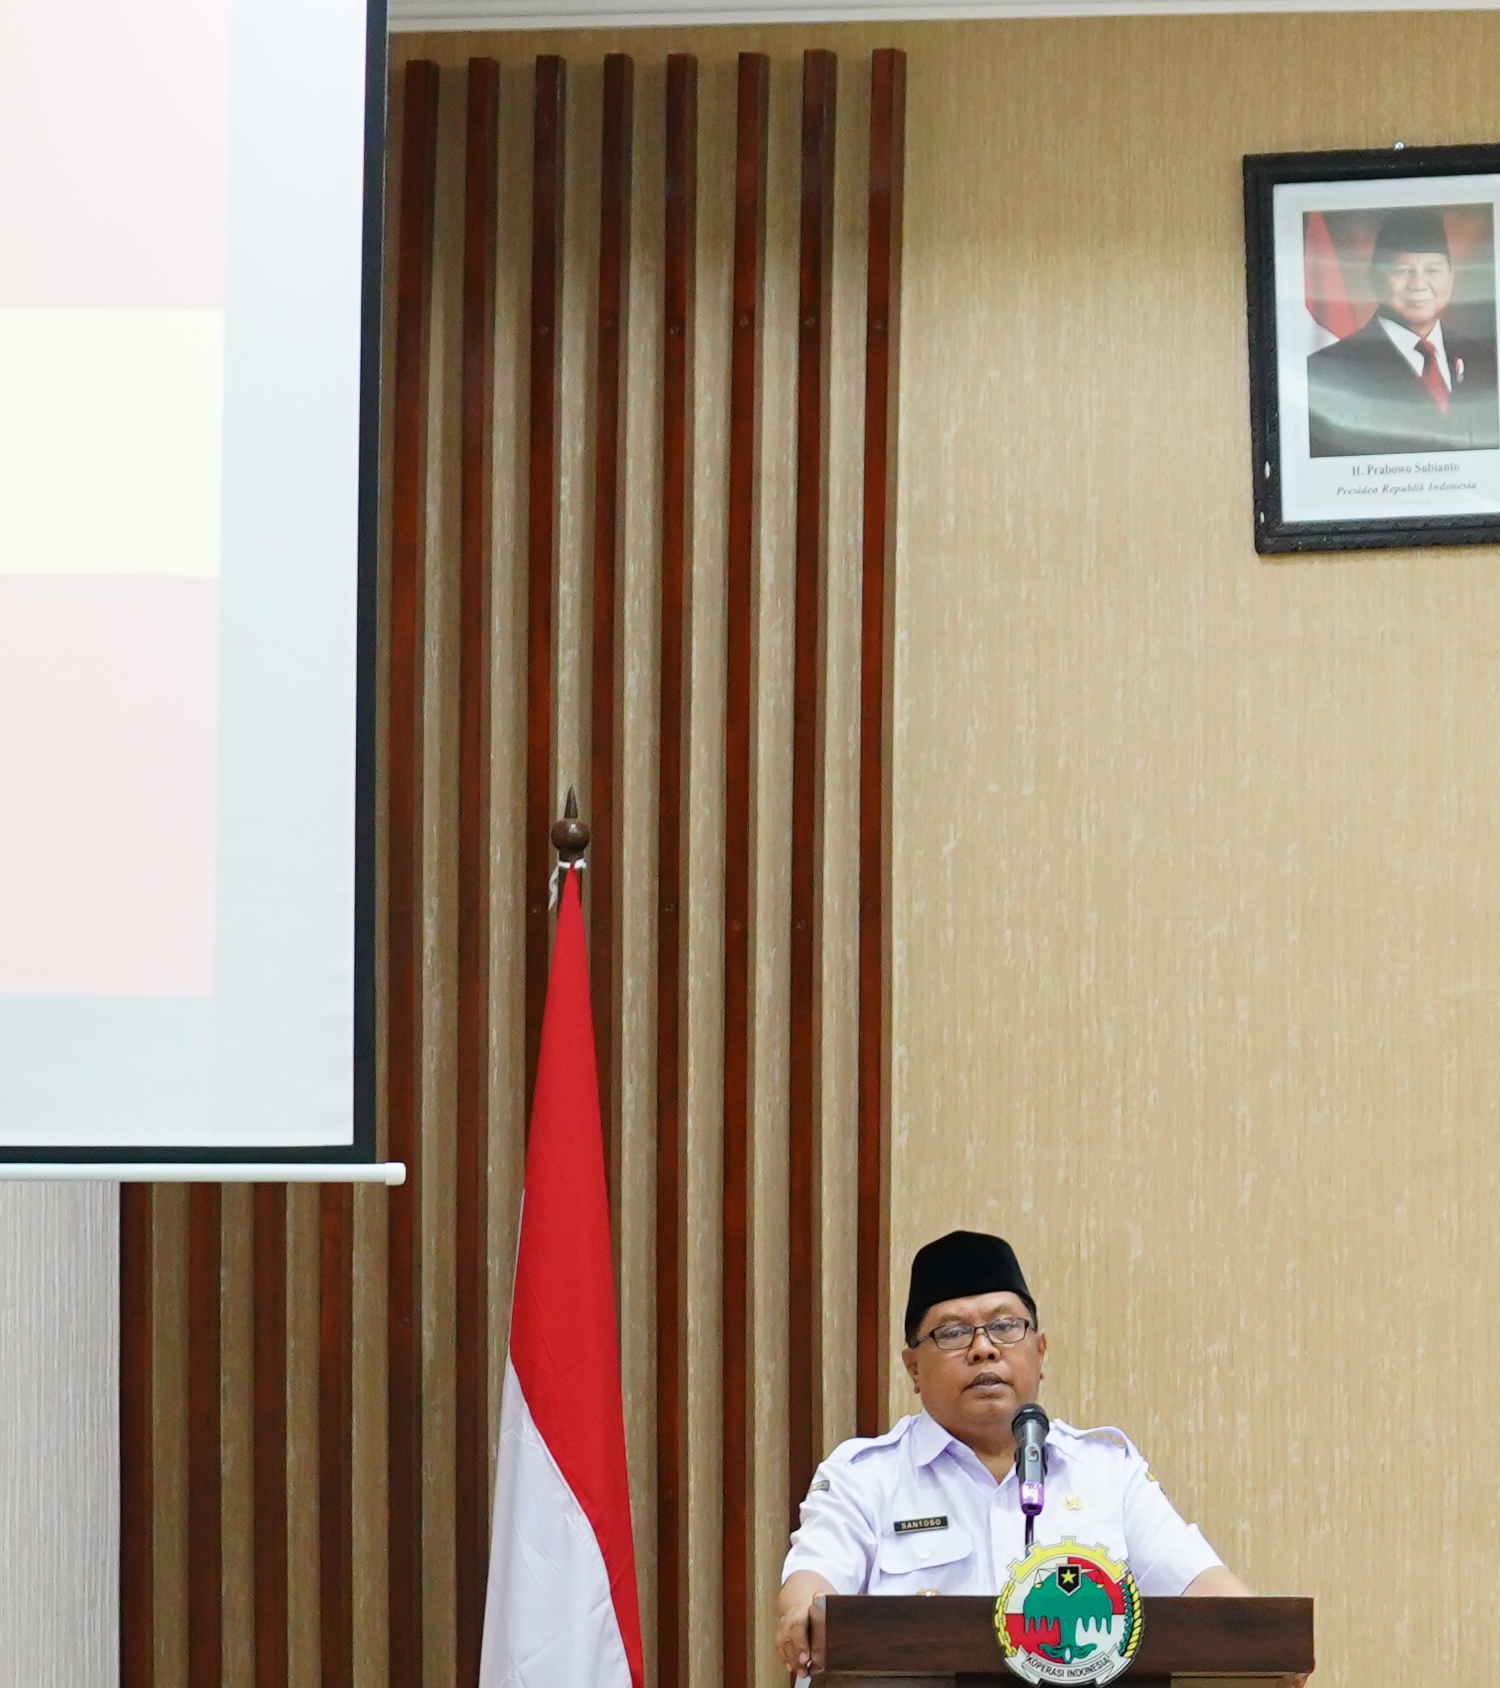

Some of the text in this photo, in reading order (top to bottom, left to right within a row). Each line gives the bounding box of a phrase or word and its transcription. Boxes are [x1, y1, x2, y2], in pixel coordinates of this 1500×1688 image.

[1352, 461, 1460, 476] H. Prabowo Subianto
[1336, 480, 1477, 496] Presiden Republik Indonesia
[901, 1519, 942, 1529] SANTOSO
[1026, 1656, 1110, 1677] KOPERASI INDONESIA
